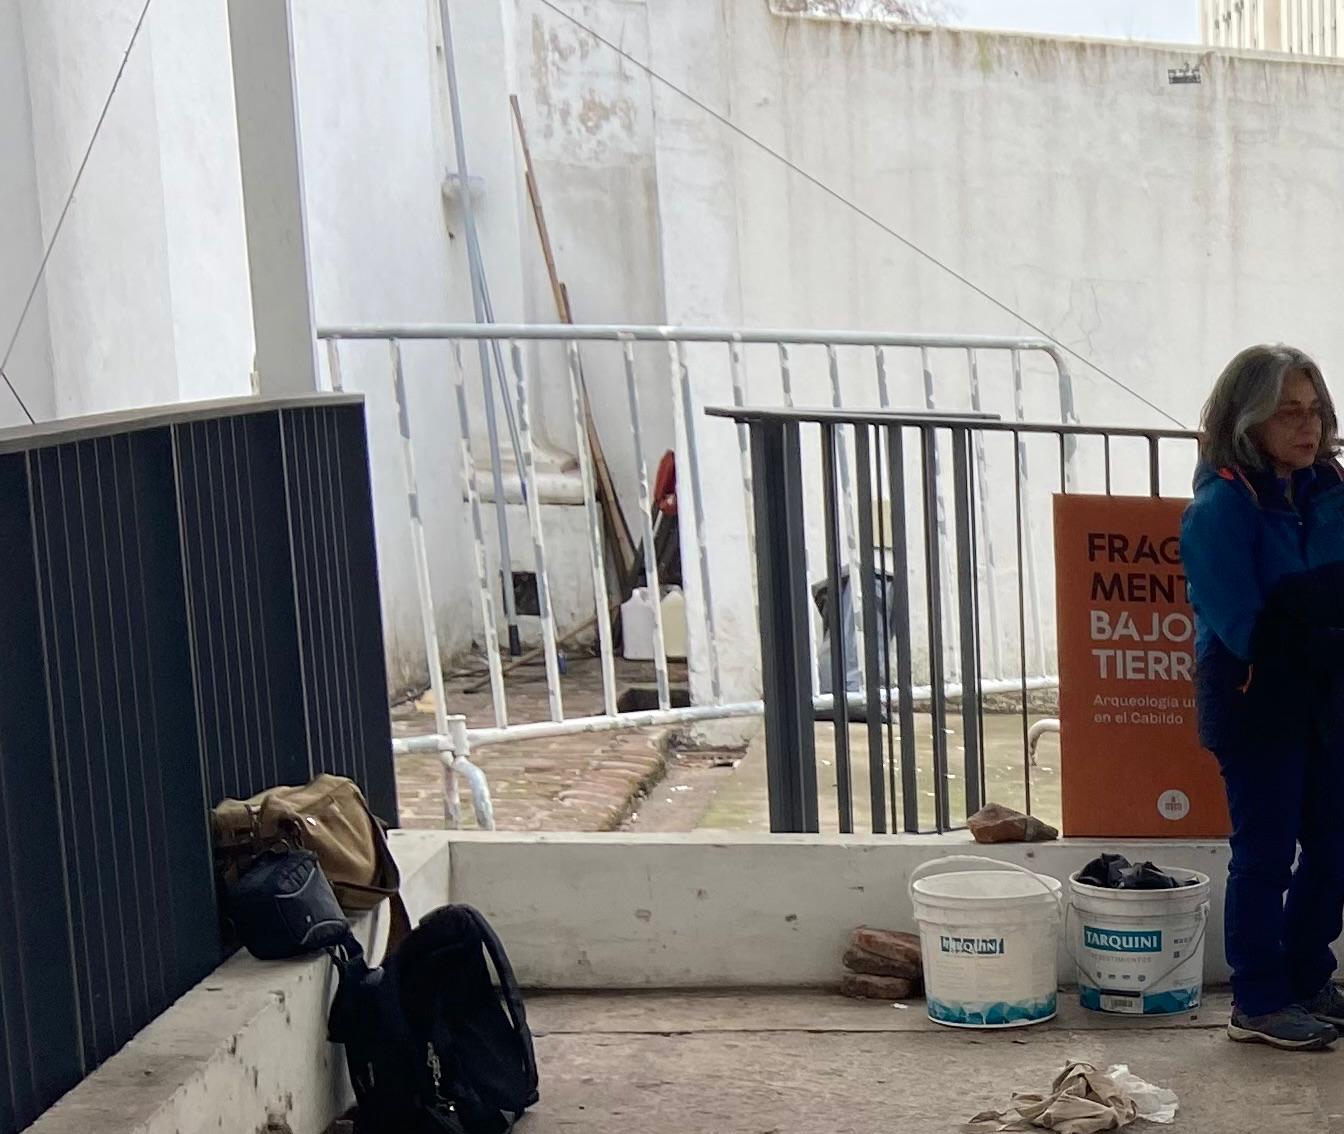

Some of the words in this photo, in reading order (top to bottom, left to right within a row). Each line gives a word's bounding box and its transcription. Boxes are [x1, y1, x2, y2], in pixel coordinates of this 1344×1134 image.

[1091, 571, 1190, 604] MENT
[1090, 609, 1193, 642] BAJO
[1091, 648, 1196, 681] TIERR
[1094, 713, 1111, 724] en
[1115, 711, 1127, 724] el
[1131, 712, 1184, 725] Cabildo
[1086, 931, 1158, 951] TARQUINI
